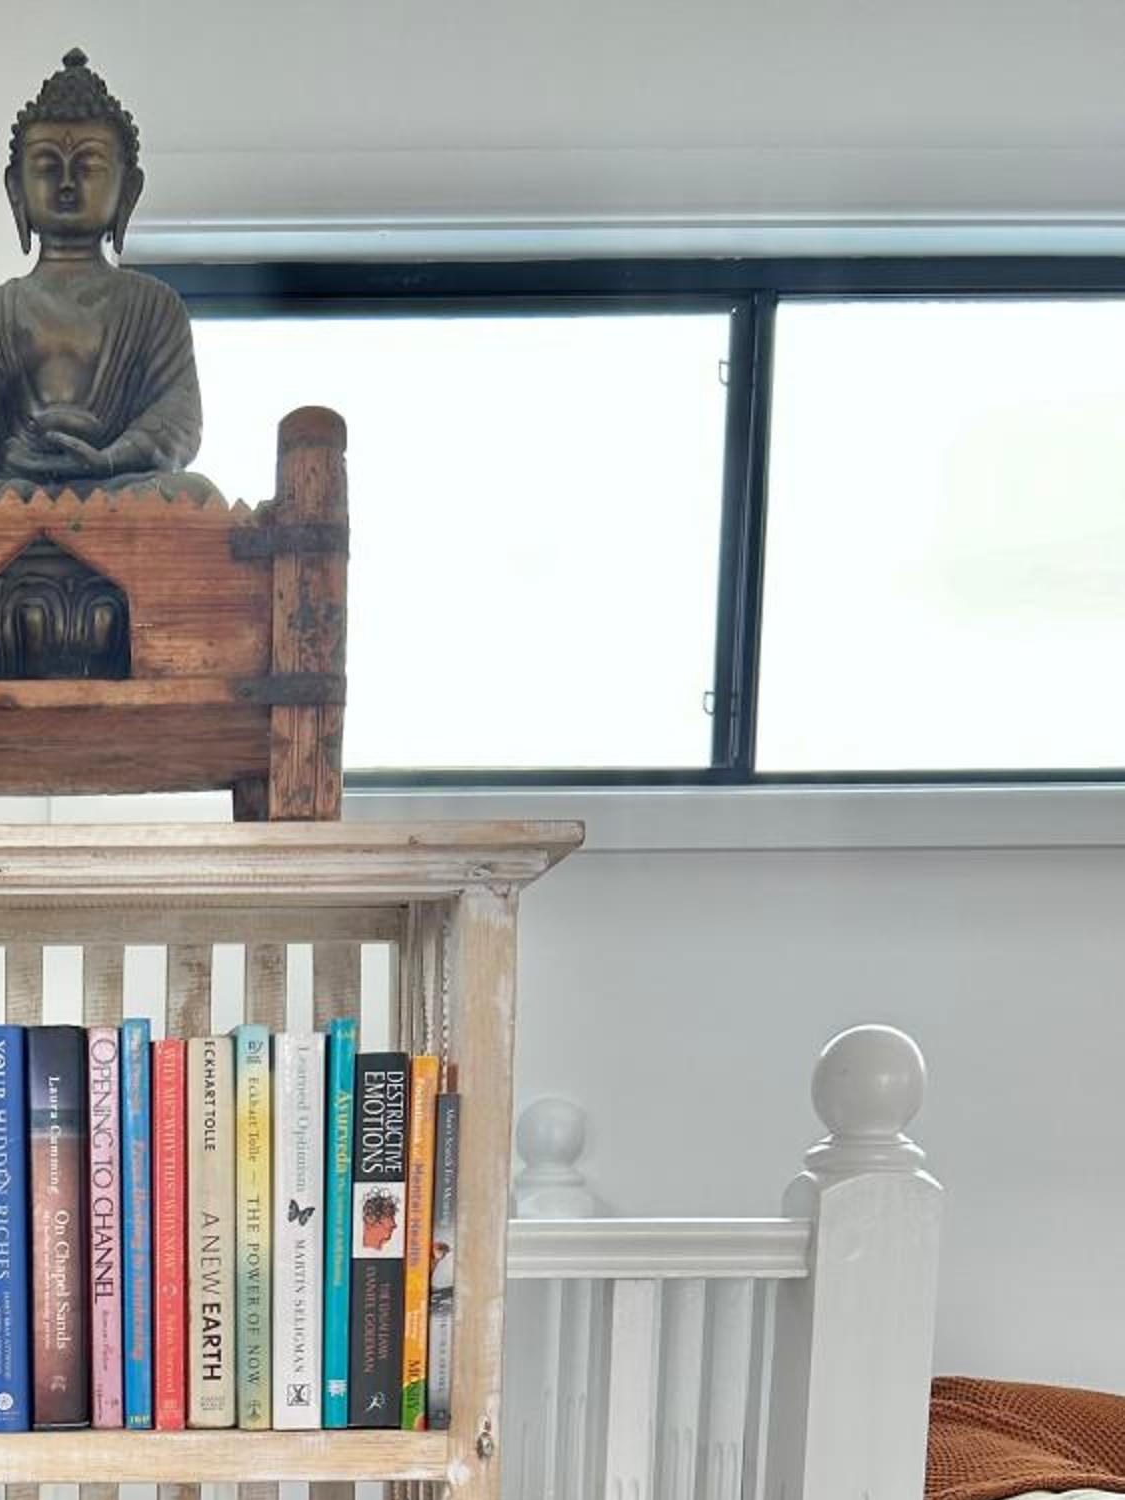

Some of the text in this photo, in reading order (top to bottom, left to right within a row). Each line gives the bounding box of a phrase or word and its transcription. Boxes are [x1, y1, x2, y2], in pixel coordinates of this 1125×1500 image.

[47, 1076, 62, 1195] Laura Cumming
[204, 1040, 216, 1152] ECKHART TOLLE
[248, 1077, 262, 1163] Eckhart Tolle
[291, 1046, 311, 1193] Learned Optimism
[334, 1090, 353, 1175] Ayurveda
[362, 1071, 386, 1173] EMOTIONS
[385, 1071, 404, 1173] DESTRUCTIVE
[91, 1039, 117, 1305] OPENING TO CHANNEL
[201, 1212, 220, 1229] A
[410, 1164, 425, 1215] Mental
[51, 1210, 71, 1350] On Chapel Sands
[201, 1235, 222, 1295] NEW
[247, 1193, 261, 1385] THE POWER OF NOW
[409, 1219, 423, 1269] Health
[202, 1303, 222, 1380] EARTH
[293, 1239, 307, 1373] MARTIN SELIGMAN
[363, 1265, 377, 1376] DANIEL GOLEMAN
